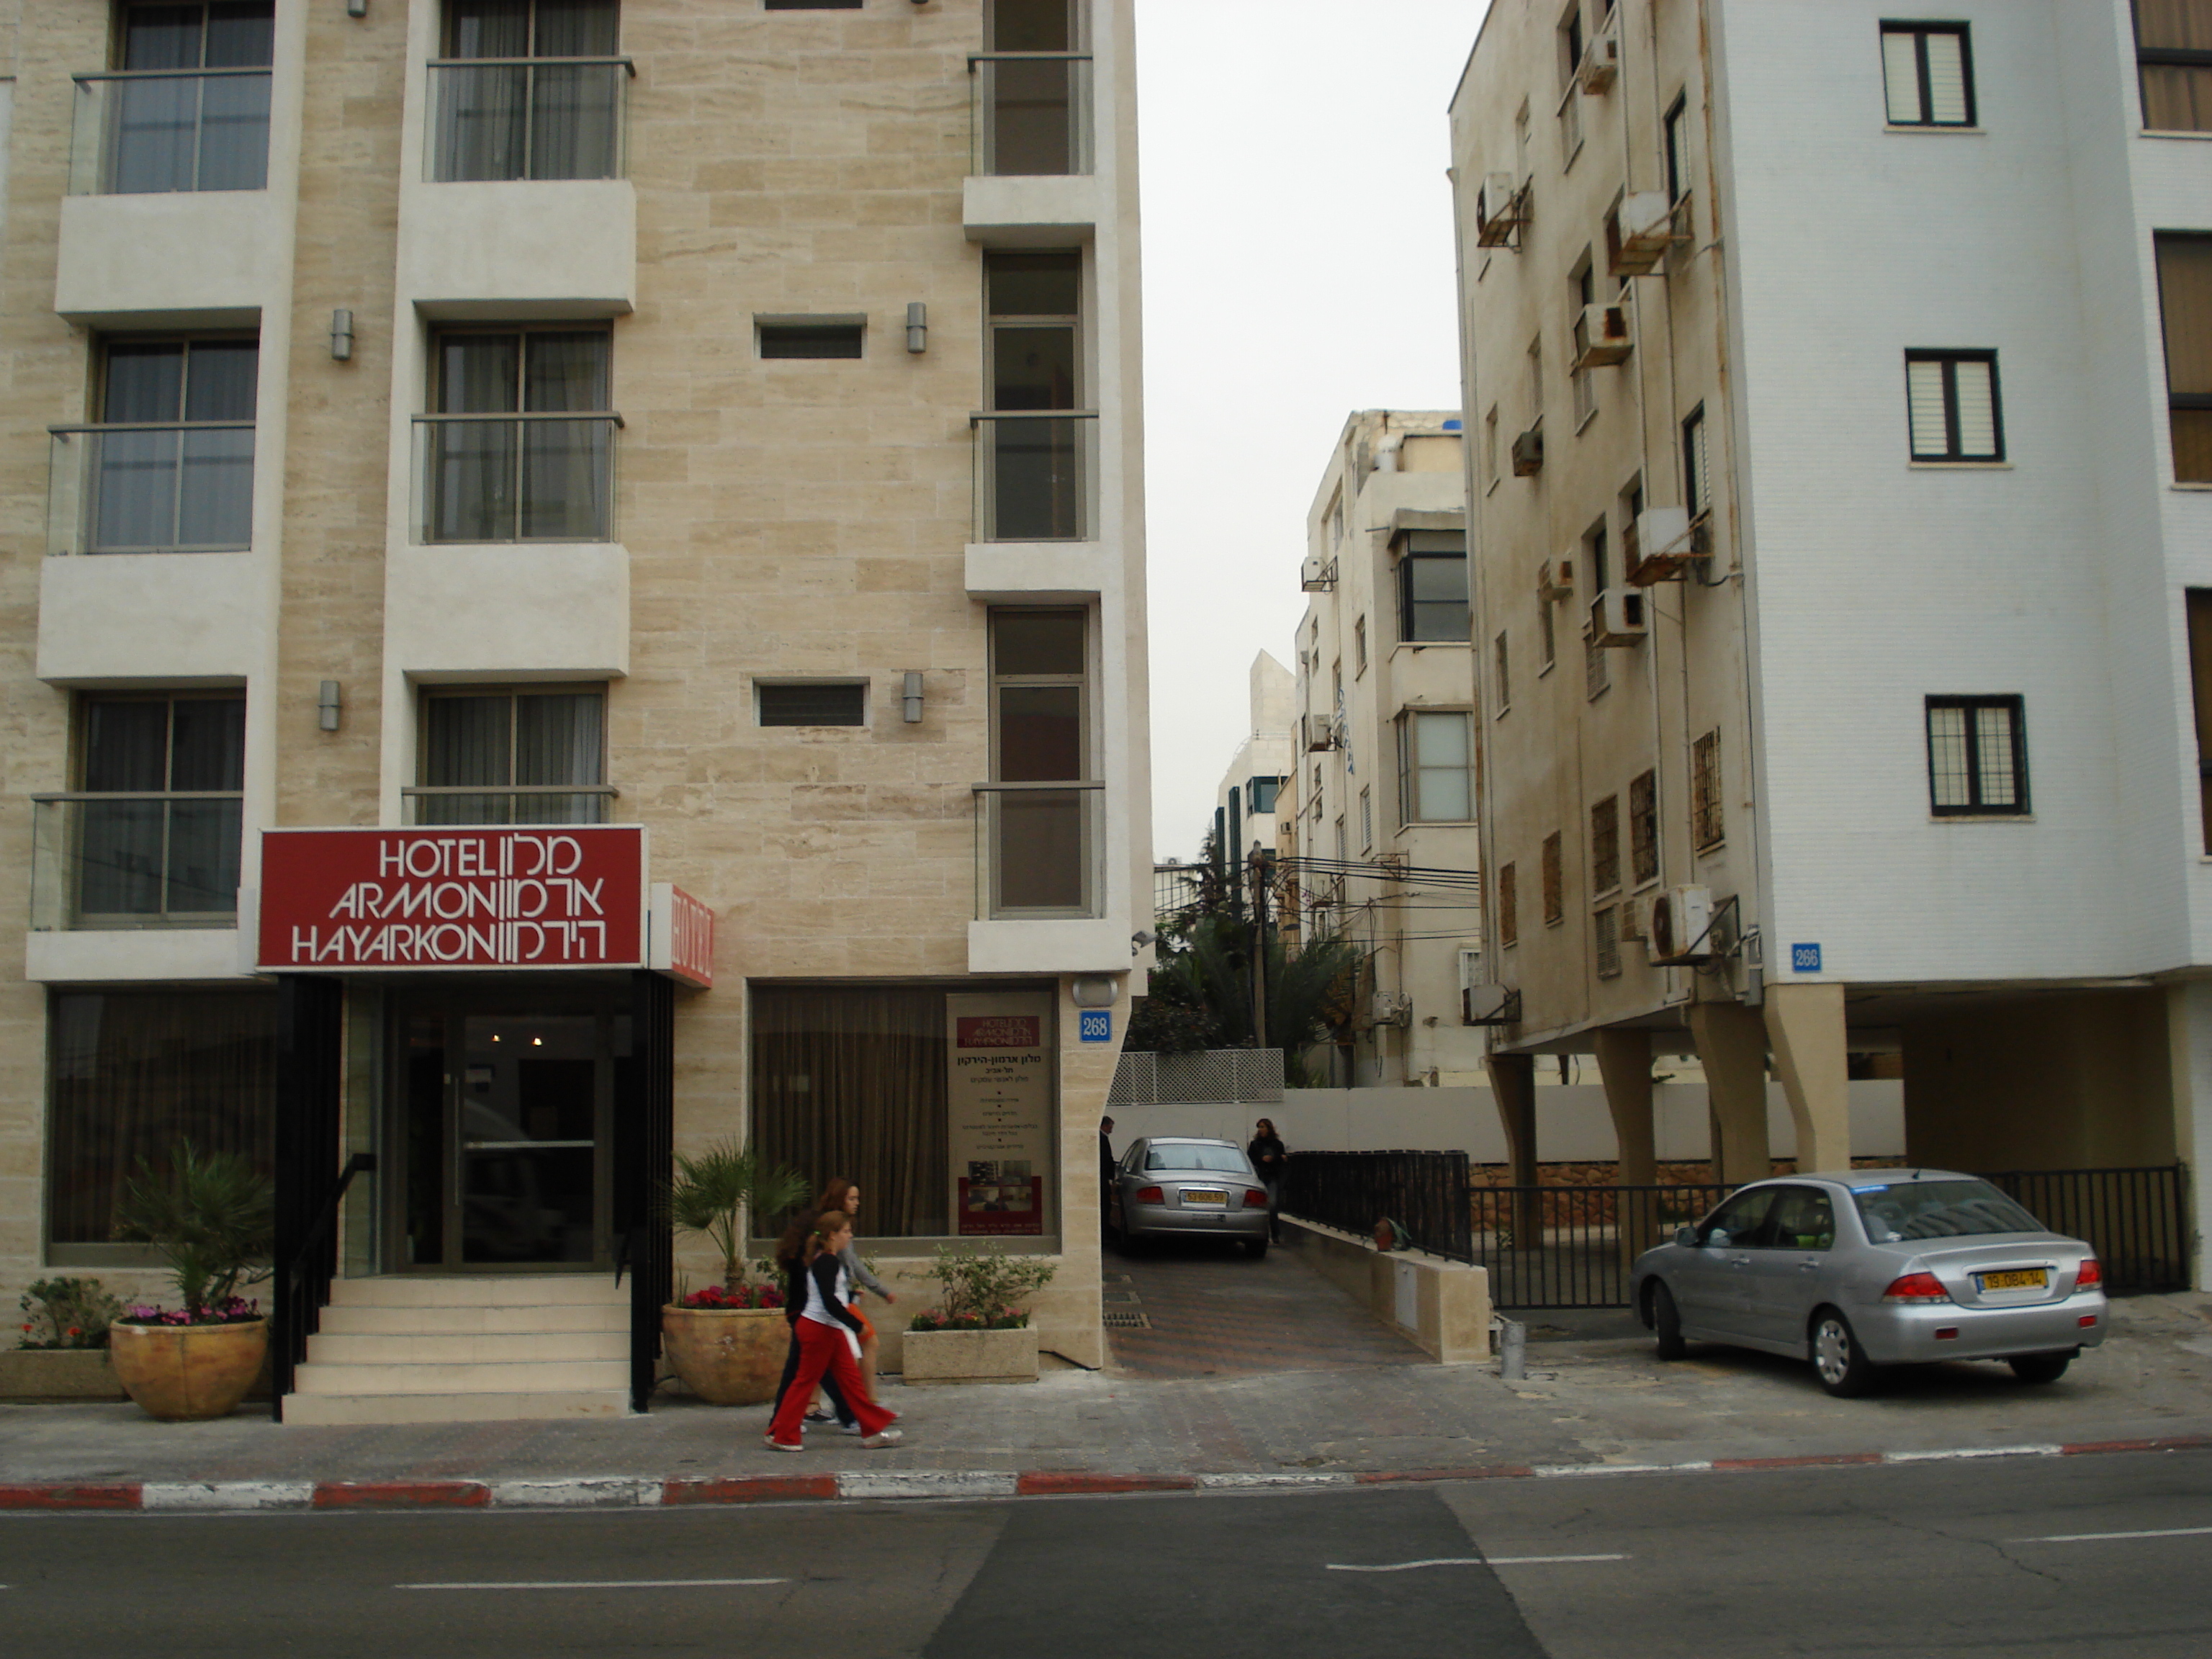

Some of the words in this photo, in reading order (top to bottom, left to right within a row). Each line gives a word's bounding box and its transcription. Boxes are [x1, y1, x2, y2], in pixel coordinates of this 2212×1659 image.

[379, 838, 497, 878] HOTEL
[498, 832, 582, 878] מלון
[329, 881, 498, 920] ARMON
[498, 878, 604, 920] ארמון
[292, 923, 498, 963] HAYARKON
[498, 920, 606, 963] הירקון
[673, 894, 711, 979] HOTEL
[1084, 1017, 1107, 1036] 268
[1021, 1053, 1041, 1065] מלון
